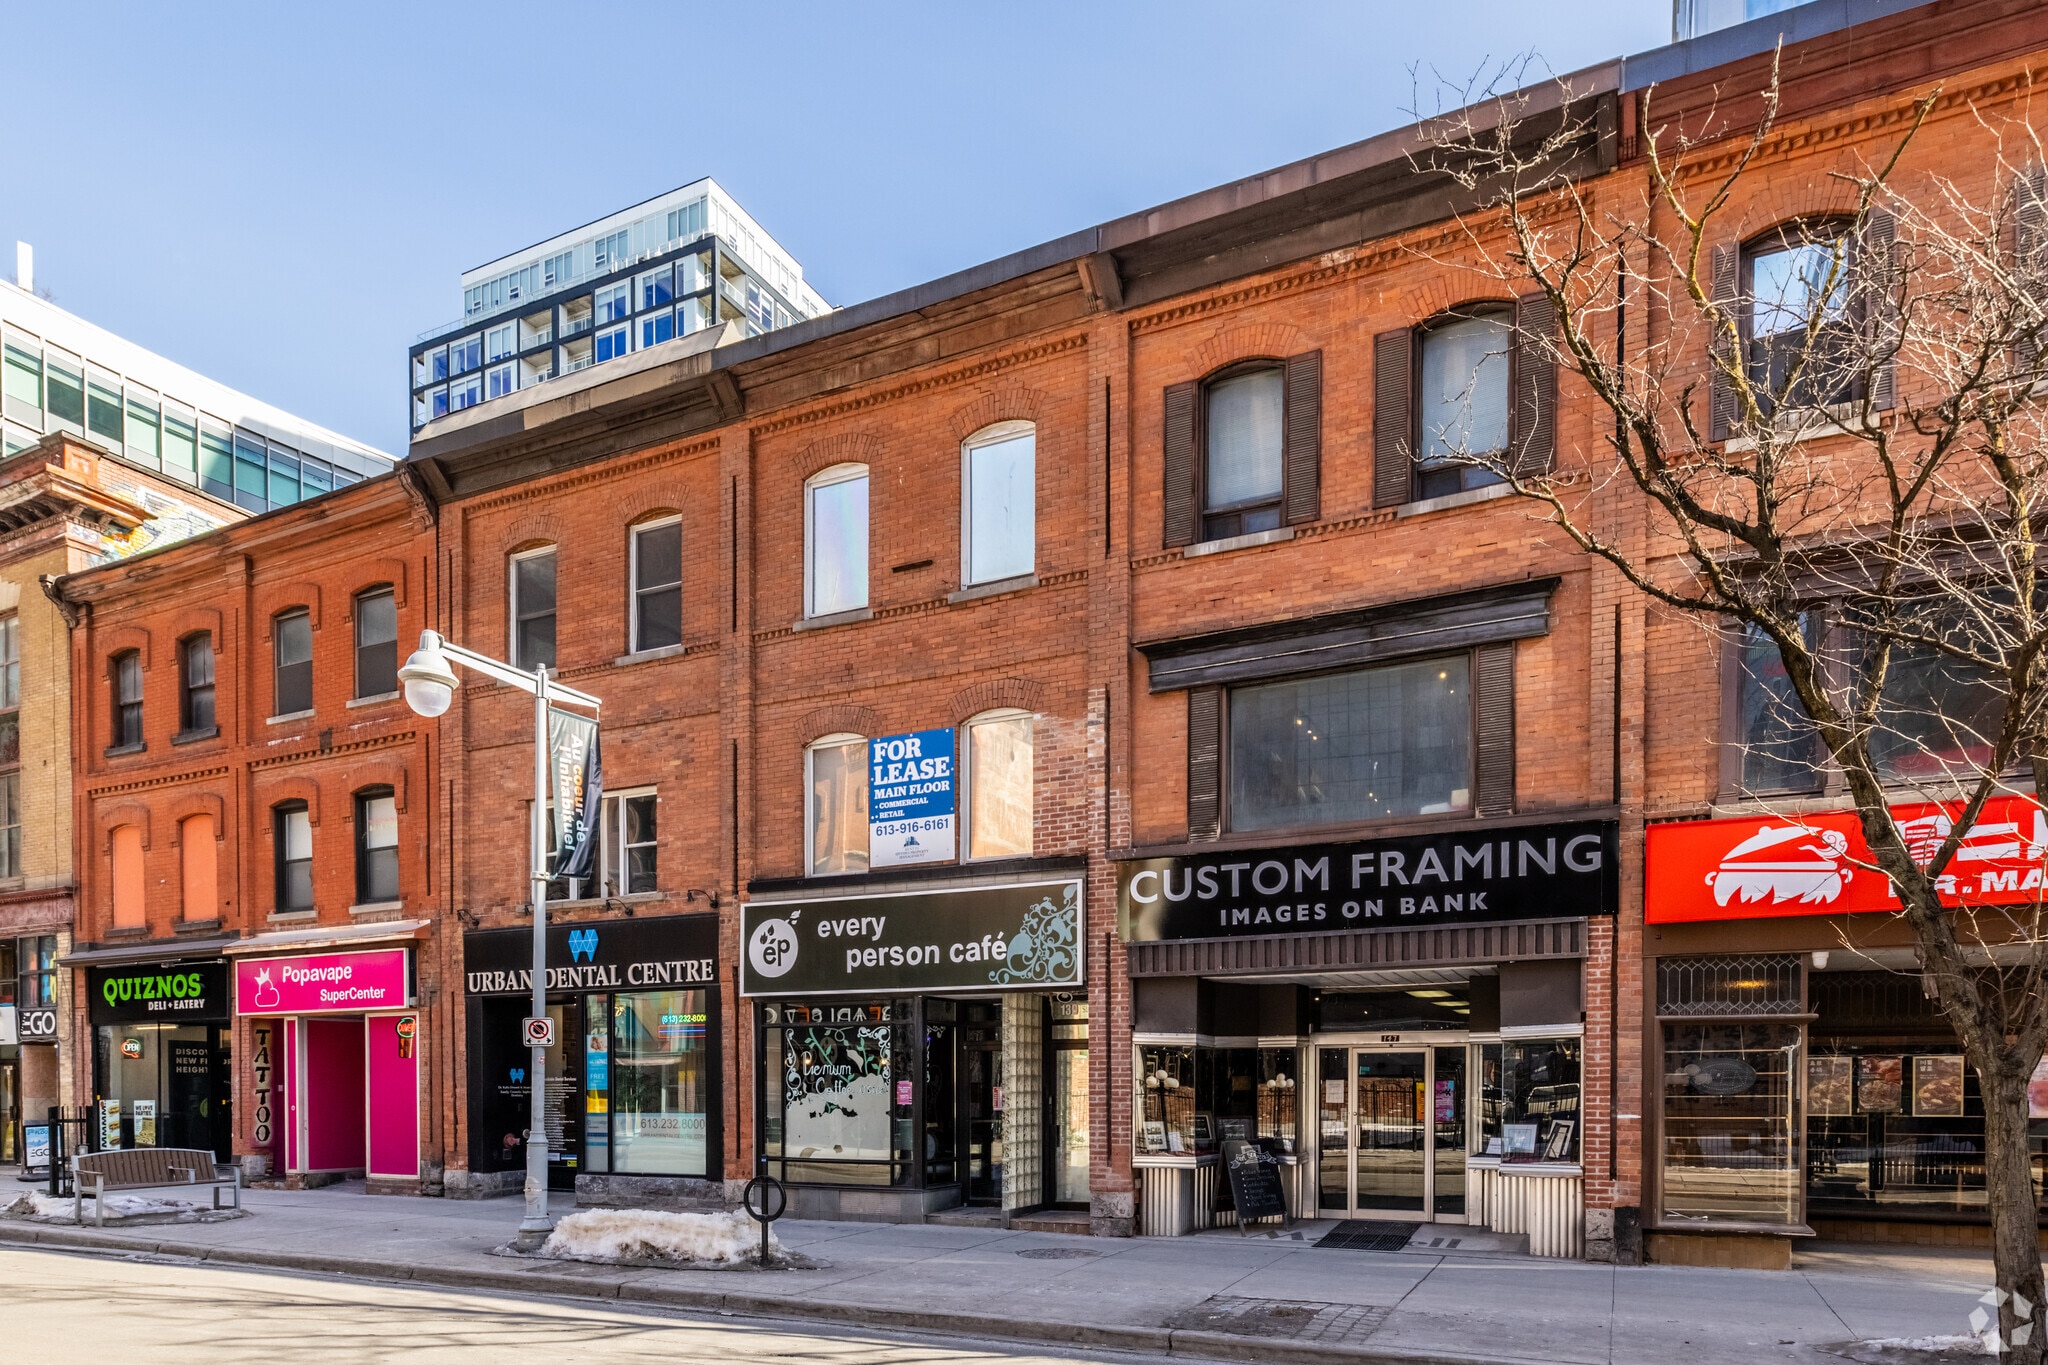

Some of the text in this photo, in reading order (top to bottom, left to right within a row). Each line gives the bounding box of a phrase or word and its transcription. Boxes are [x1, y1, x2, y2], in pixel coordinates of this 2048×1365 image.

[873, 737, 922, 763] FOR
[873, 756, 950, 786] LEASE
[559, 745, 576, 851] l'inhabituel
[571, 733, 588, 843] Au coeur de
[874, 780, 950, 800] MAIN FLOOR
[879, 797, 929, 809] COMMERCIAL
[879, 809, 905, 819] RETAIL
[876, 818, 949, 837] 613-916-6161
[1130, 834, 1602, 904] CUSTOM FRAMING
[1888, 868, 2048, 898] R.MA
[1220, 892, 1488, 926] IMAGES ON BANK
[817, 916, 886, 941] every
[846, 931, 1008, 973] person café
[282, 965, 352, 986] Popavape
[468, 959, 715, 993] URBAN DENTAL CENTRE
[103, 973, 201, 1007] QUIZNOS
[320, 986, 386, 1004] SuperCenter
[148, 1000, 167, 1011] DELI
[174, 999, 206, 1010] EATERY
[123, 1043, 139, 1053] OPEN
[176, 1057, 198, 1065] NEW
[254, 1029, 271, 1142] TATTOO
[640, 1118, 706, 1130] 613.232.8000
